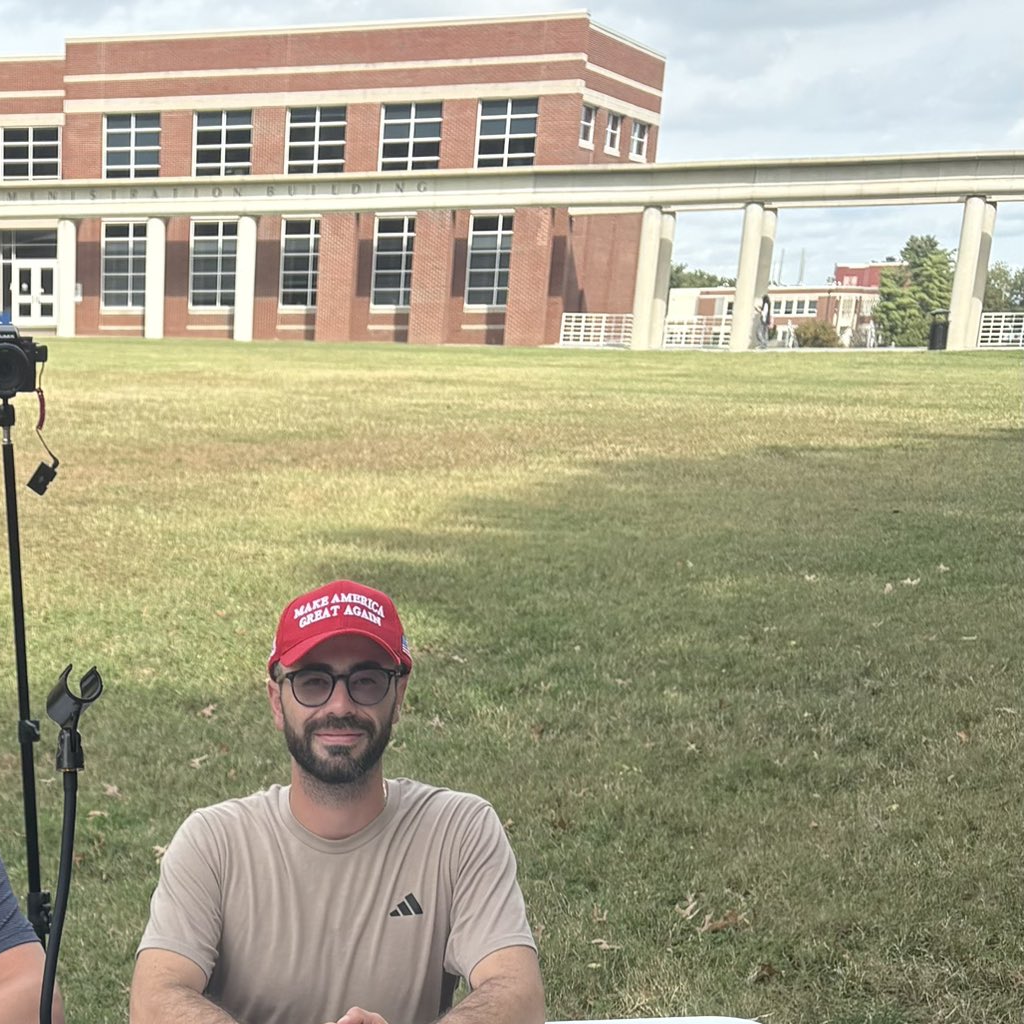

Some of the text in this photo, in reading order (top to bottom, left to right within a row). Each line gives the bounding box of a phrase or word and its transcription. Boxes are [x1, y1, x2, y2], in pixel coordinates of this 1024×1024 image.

[266, 181, 428, 197] BUILDING
[294, 593, 385, 619] MAKE AMERICA
[299, 604, 382, 628] GREAT AGAIN
